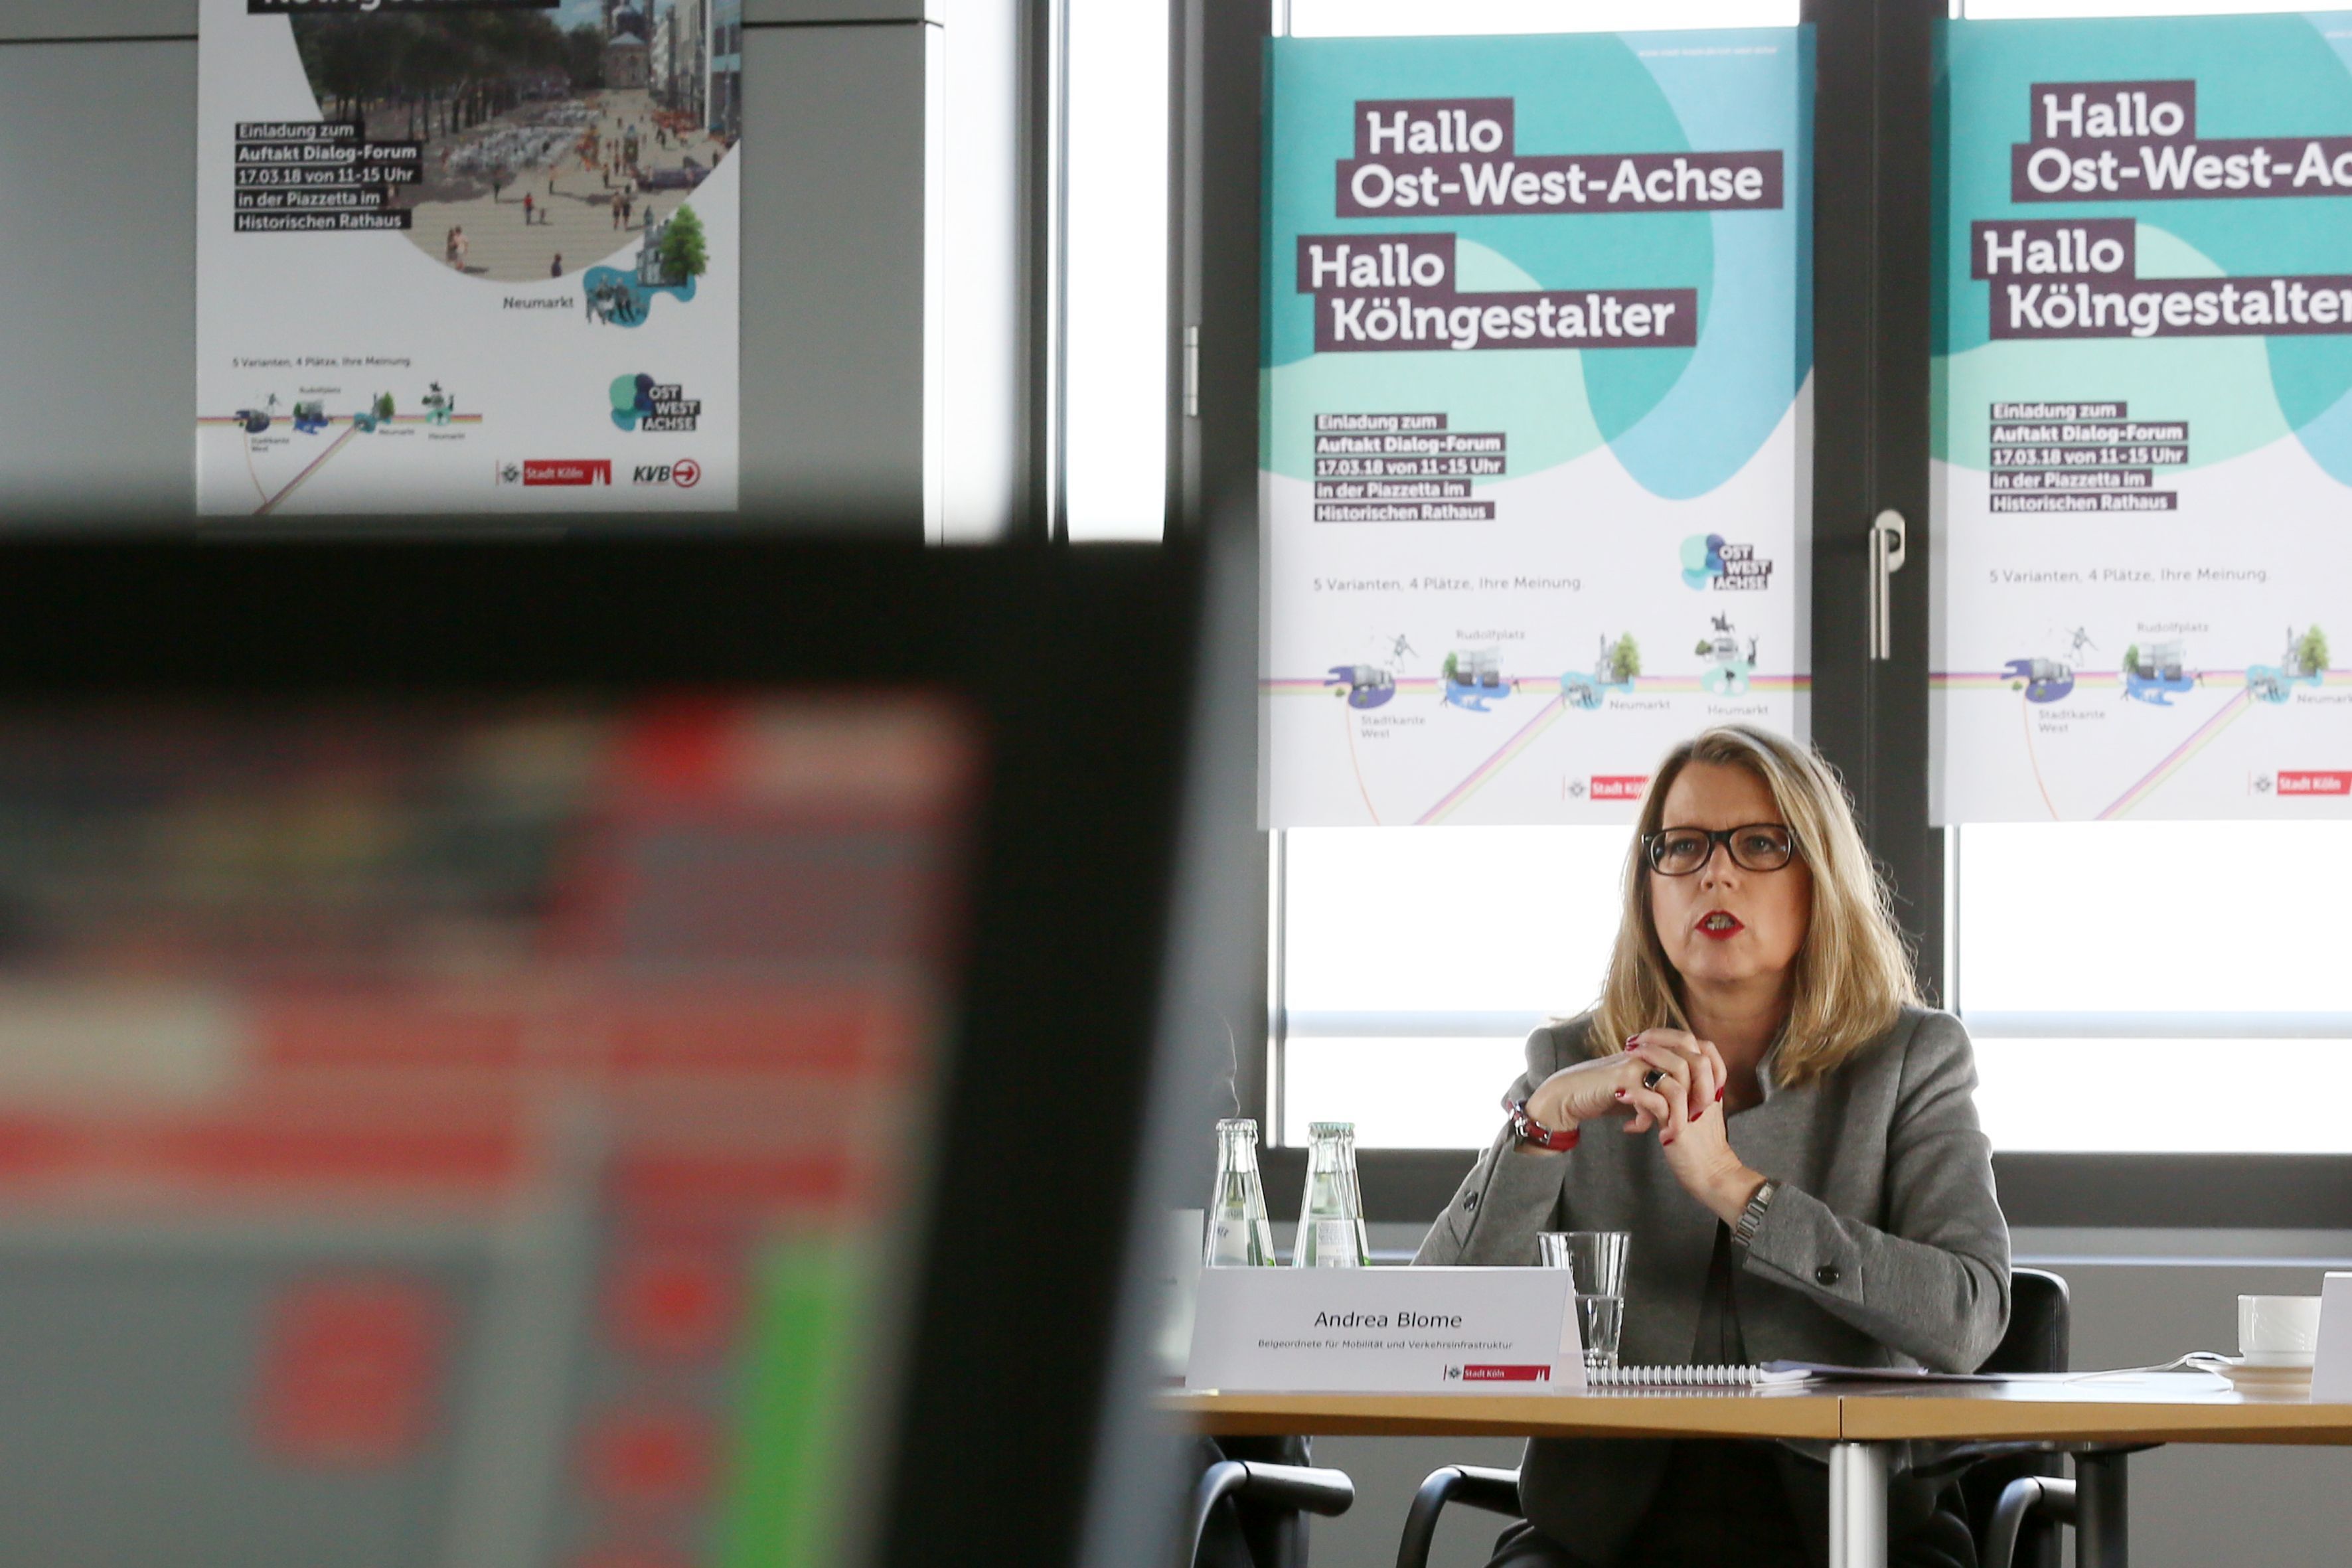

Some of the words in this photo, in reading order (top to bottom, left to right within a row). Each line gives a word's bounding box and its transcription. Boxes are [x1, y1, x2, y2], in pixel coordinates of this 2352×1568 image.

[2043, 92, 2184, 138] Hallo
[240, 124, 316, 140] Einladung
[320, 125, 354, 136] zum
[1367, 109, 1504, 155] Hallo
[239, 147, 299, 161] Auftakt
[303, 145, 416, 163] Dialog-Forum
[239, 169, 299, 183] 17.03.18
[305, 171, 333, 183] von
[338, 168, 380, 182] 11-15
[384, 168, 414, 181] Uhr
[1350, 157, 1764, 209] Ost-West-Achse
[238, 193, 252, 206] in
[257, 192, 282, 206] der
[287, 191, 356, 206] Piazzetta
[360, 191, 380, 204] im
[238, 214, 335, 229] Historischen
[339, 213, 401, 228] Rathaus
[1984, 228, 2124, 274] Hallo
[1309, 242, 1446, 288] Hallo
[503, 297, 574, 309] Neumarkt
[1331, 293, 1676, 351] Kölngestalter
[649, 387, 680, 400] OST
[655, 402, 698, 415] WEST
[1993, 404, 2076, 420] Einladung
[2080, 405, 2116, 418] zum
[644, 418, 694, 431] ACHSE
[1318, 414, 1399, 431] Einladung
[1401, 416, 1437, 429] zum
[1993, 426, 2058, 441] Auftakt
[2063, 425, 2183, 444] Dialog-Forum
[1318, 437, 1381, 453] Auftakt
[1384, 435, 1500, 455] Dialog-Forum
[1993, 449, 2061, 464] 17.03.18
[2065, 451, 2096, 463] von
[2152, 447, 2183, 463] Uhr
[526, 467, 556, 479] Stadt
[558, 467, 584, 479] Köln
[633, 466, 670, 482] KVB
[1318, 459, 1383, 475] 17.03.18
[1386, 462, 1417, 475] von
[1470, 459, 1501, 473] Uhr
[1993, 473, 2009, 488] in
[2012, 472, 2041, 487] der
[2045, 471, 2120, 487] Piazzetta
[2124, 471, 2145, 486] im
[1318, 483, 1333, 498] in
[1336, 482, 1364, 497] der
[1367, 482, 1440, 497] Piazzetta
[1444, 481, 1464, 496] im
[1993, 495, 2096, 510] Historischen
[2100, 495, 2167, 510] Rathaus
[1318, 505, 1418, 520] Historischen
[1421, 504, 1486, 520] Rathaus
[1719, 546, 1753, 560] OST
[1727, 561, 1770, 575] WEST
[1314, 578, 1322, 591] 5
[1328, 578, 1403, 591] Varianten,
[1410, 578, 1418, 589] 4
[1425, 576, 1474, 591] Plätze,
[1480, 576, 1509, 589] Ihre
[1717, 576, 1766, 589] ACHSE
[1990, 570, 1998, 584] 5
[2004, 569, 2082, 584] Varianten,
[2089, 570, 2098, 582] 4
[2104, 568, 2155, 584] Plätze,
[2161, 568, 2191, 582] Ihre
[1456, 629, 1526, 641] Rudolfplatz
[2137, 623, 2209, 633] Rudolfplatz
[1610, 700, 1671, 710] Neumarkt
[1708, 706, 1768, 716] Heumarkt
[1361, 716, 1426, 726] Stadtkante
[2039, 710, 2106, 720] Stadtkante
[1361, 730, 1390, 738] West
[2039, 723, 2069, 733] West
[1593, 781, 1622, 794] Stadt
[2279, 777, 2311, 790] Stadt
[2313, 776, 2341, 790] Köln
[1314, 1311, 1388, 1328] Andrea
[1397, 1312, 1462, 1328] Blome
[1258, 1340, 1322, 1350] Beigeordnete
[1326, 1340, 1338, 1349] für
[1342, 1340, 1383, 1349] Mobilität
[1386, 1340, 1405, 1349] und
[1409, 1340, 1512, 1350] Verkehrsinfrastruktur
[1487, 1369, 1504, 1377] Köln
